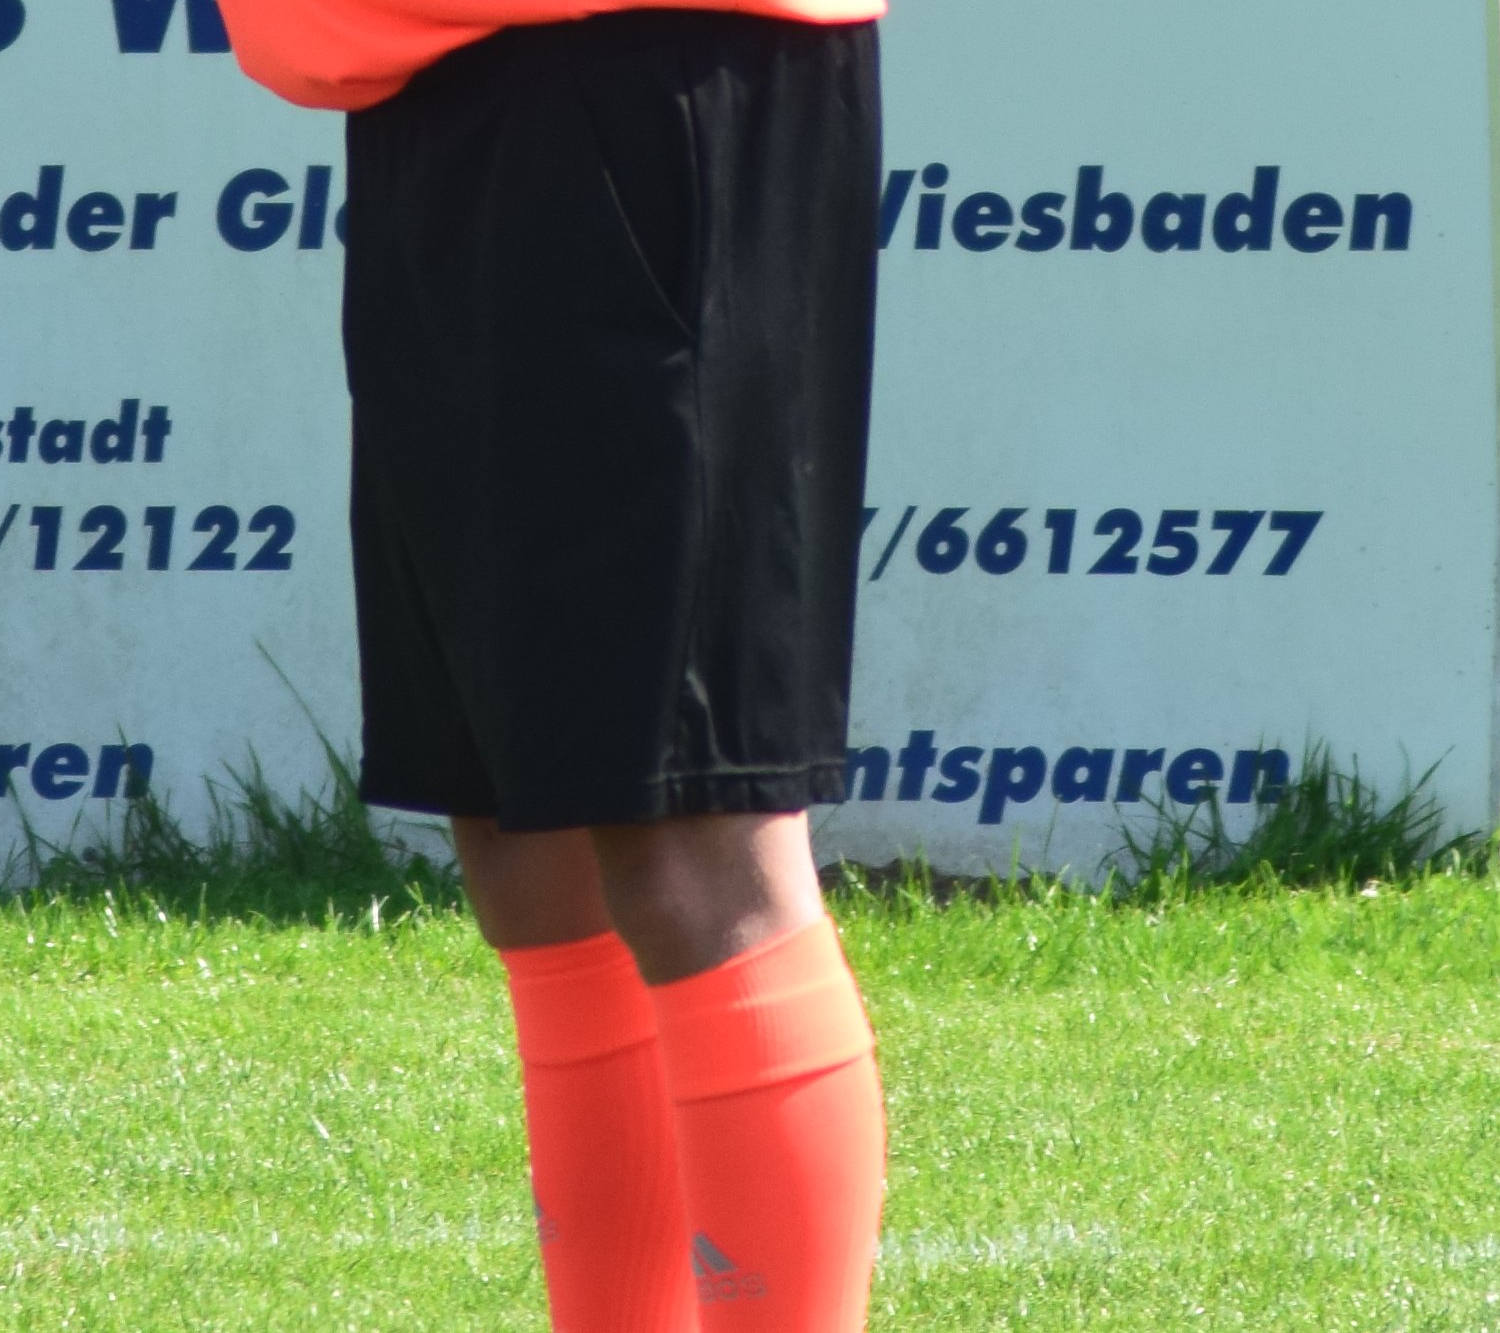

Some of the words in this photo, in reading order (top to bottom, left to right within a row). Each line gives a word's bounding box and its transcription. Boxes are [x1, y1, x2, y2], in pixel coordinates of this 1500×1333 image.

[215, 164, 348, 253] Gl
[876, 162, 1415, 253] iesbaden
[860, 505, 1324, 582] /6612577
[845, 728, 1292, 825] ntsparen
